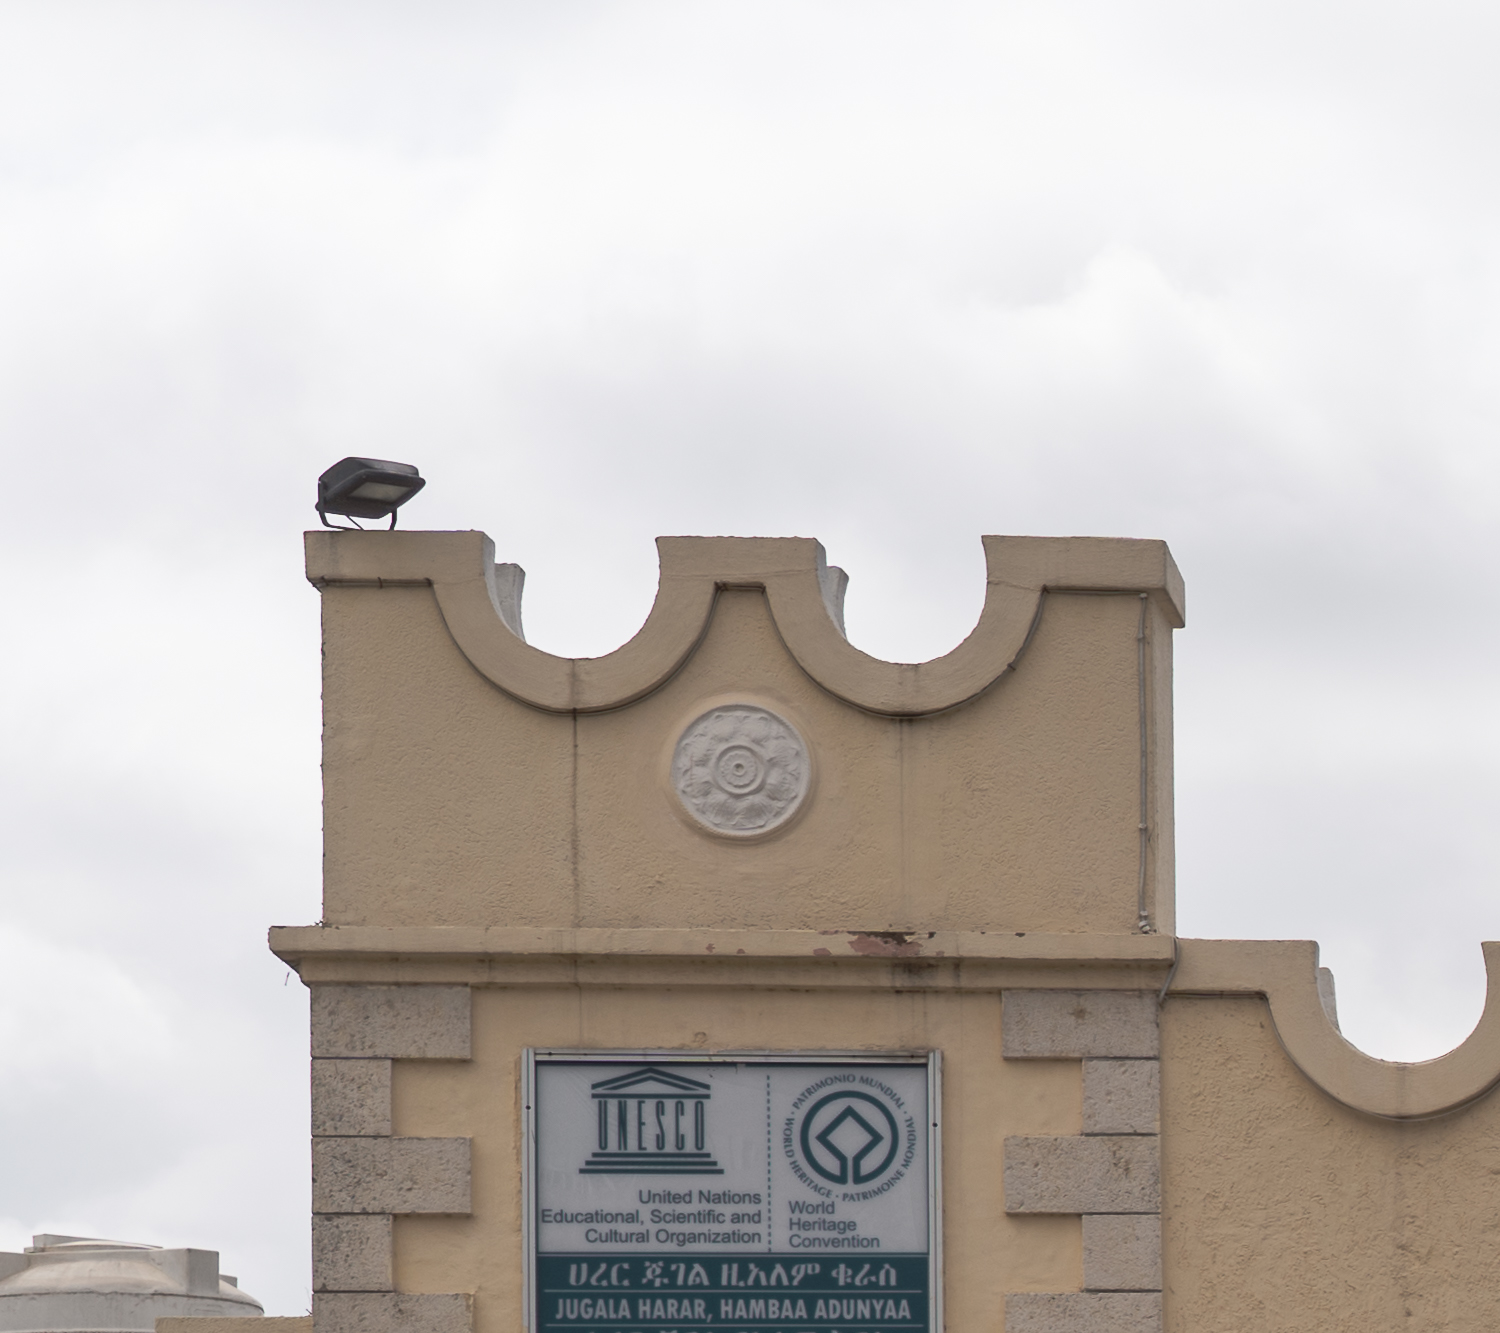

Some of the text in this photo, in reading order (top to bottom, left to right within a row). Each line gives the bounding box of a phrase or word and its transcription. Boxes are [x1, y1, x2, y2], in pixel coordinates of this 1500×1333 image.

[792, 1074, 905, 1109] PATRIMONIO MUNDIAL
[598, 1100, 705, 1151] UNESCO
[784, 1117, 834, 1199] WORLD HERITAGE
[841, 1115, 916, 1202] PATRIMOINE MONDIAL
[639, 1190, 761, 1205] United Nations
[789, 1201, 835, 1214] World
[541, 1210, 761, 1225] Educational, Scientific and
[789, 1218, 856, 1234] Heritage
[586, 1229, 761, 1246] Cultural Organization
[789, 1235, 880, 1248] Convention
[569, 1263, 630, 1286] ሀረር
[720, 1263, 821, 1287] ዚአለም
[831, 1263, 897, 1286] ቁራስ
[555, 1299, 911, 1322] JUGALA HARAR, HAMBAA ADUNYAA
